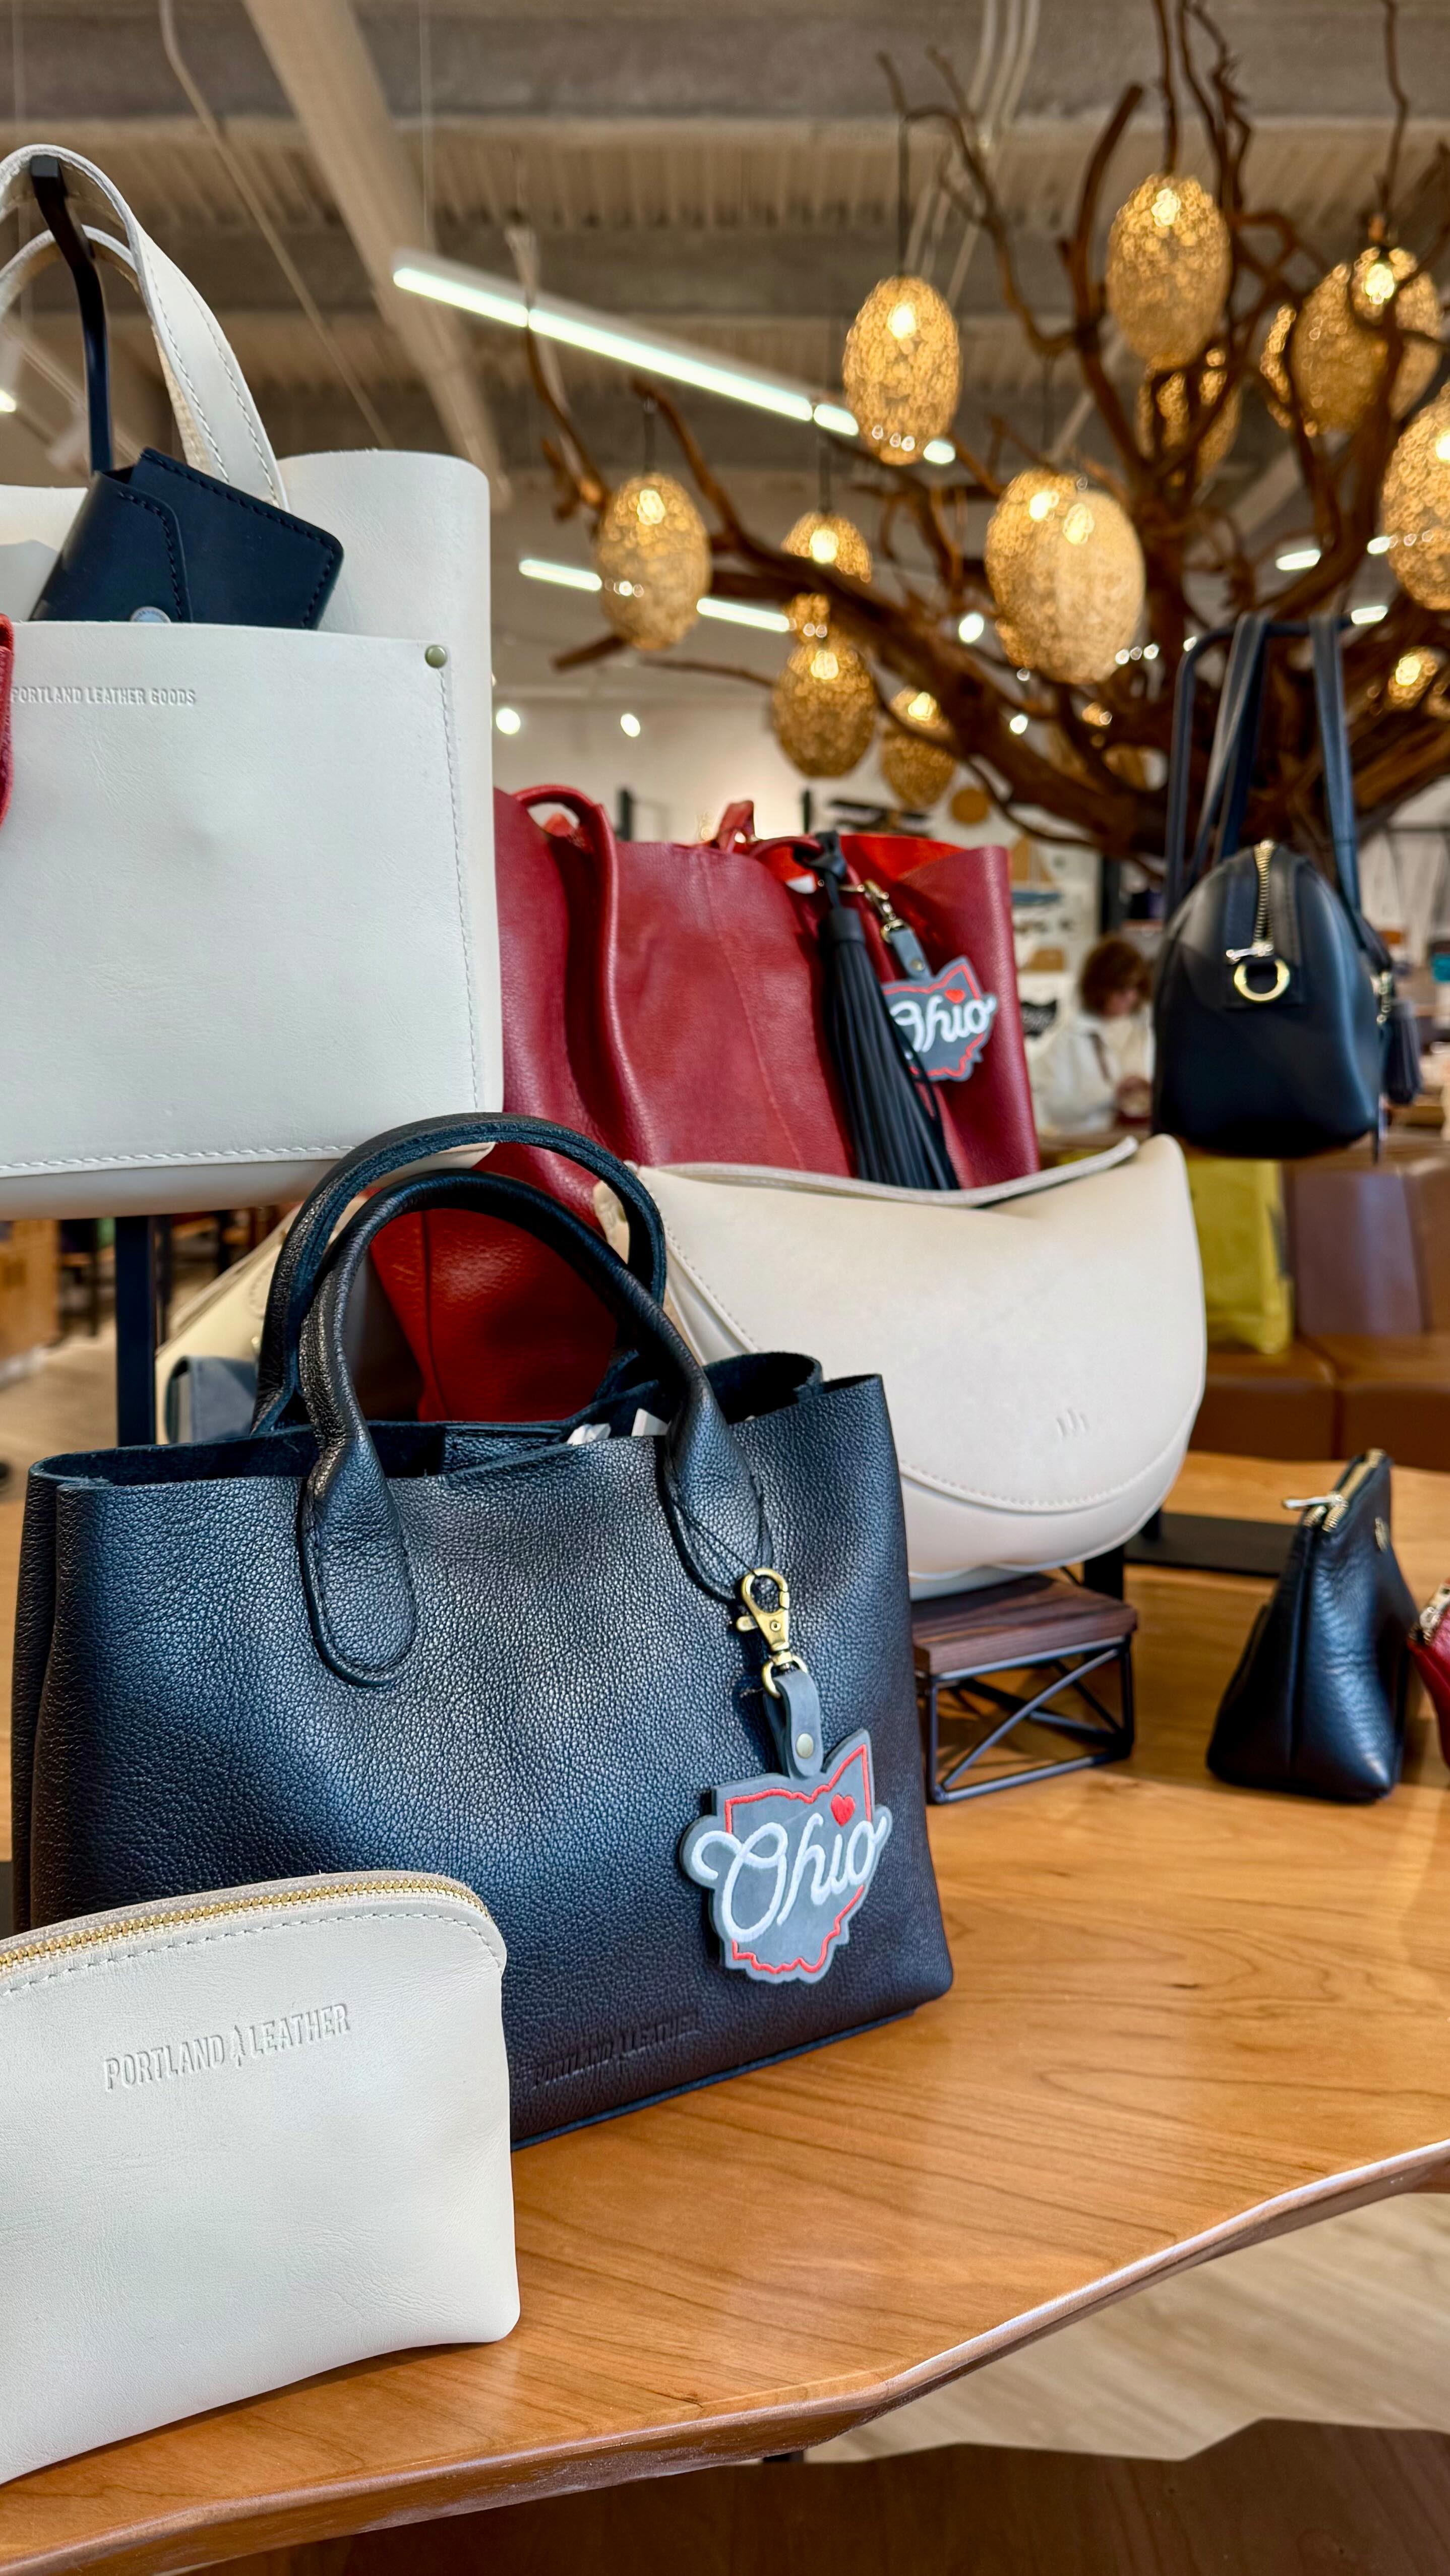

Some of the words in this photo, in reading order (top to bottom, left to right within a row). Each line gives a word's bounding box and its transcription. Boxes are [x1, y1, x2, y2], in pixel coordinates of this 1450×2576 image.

[11, 686, 82, 704] PORTLAND
[86, 687, 146, 705] LEATHER
[150, 689, 196, 706] GOODS
[691, 1812, 887, 1942] Ohio
[103, 2035, 225, 2092] PORTLAND
[249, 2002, 352, 2059] LEATHER
